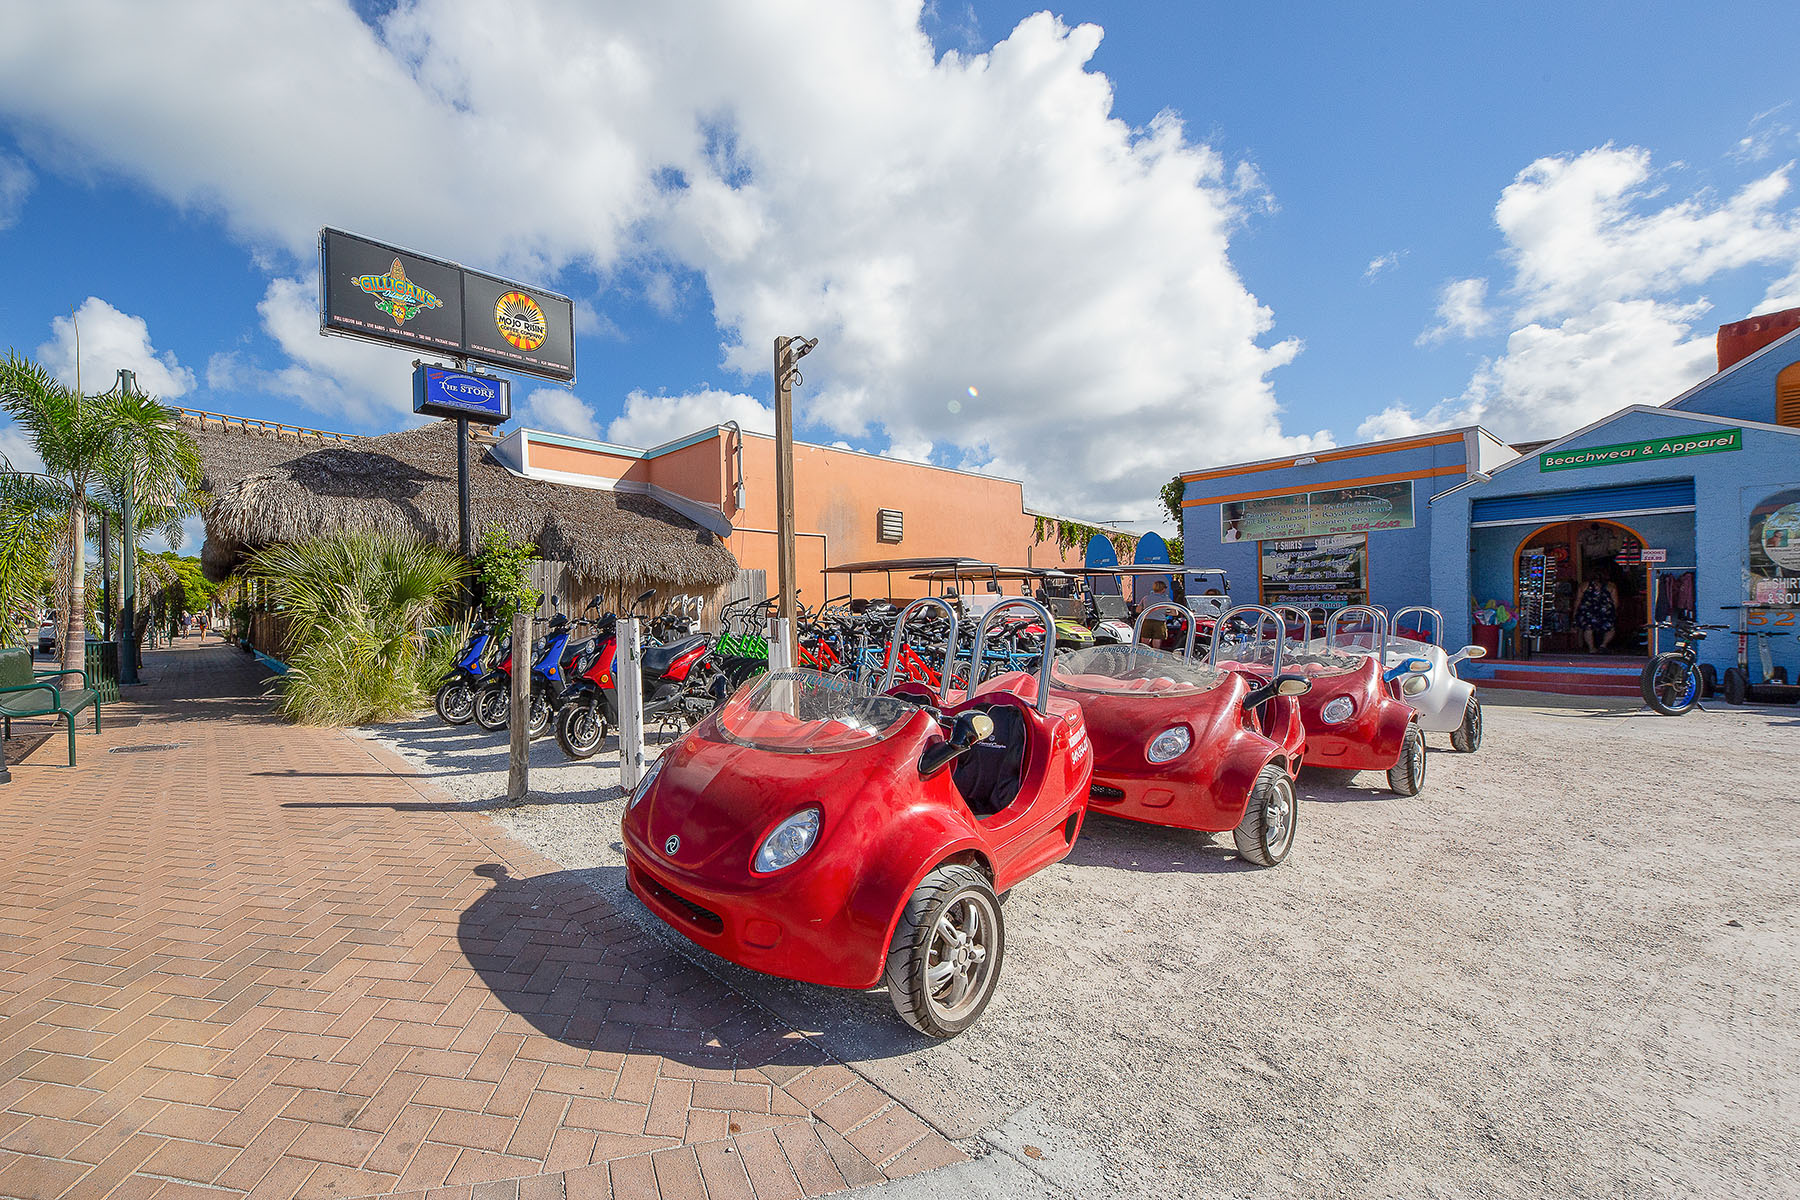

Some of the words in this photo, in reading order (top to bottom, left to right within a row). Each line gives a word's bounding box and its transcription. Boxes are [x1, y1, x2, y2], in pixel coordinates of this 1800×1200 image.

[360, 276, 434, 306] GILLIGAN'S
[498, 316, 521, 328] MOJO
[438, 381, 458, 392] THE
[460, 385, 495, 399] STORE
[1545, 448, 1637, 466] Beachwear
[1642, 445, 1654, 455] &
[1659, 434, 1734, 453] Apparel
[1322, 509, 1354, 518] Kayaks
[1274, 540, 1303, 551] T-SHIRTS
[1322, 593, 1349, 601] Cars
[1767, 593, 1775, 605] &
